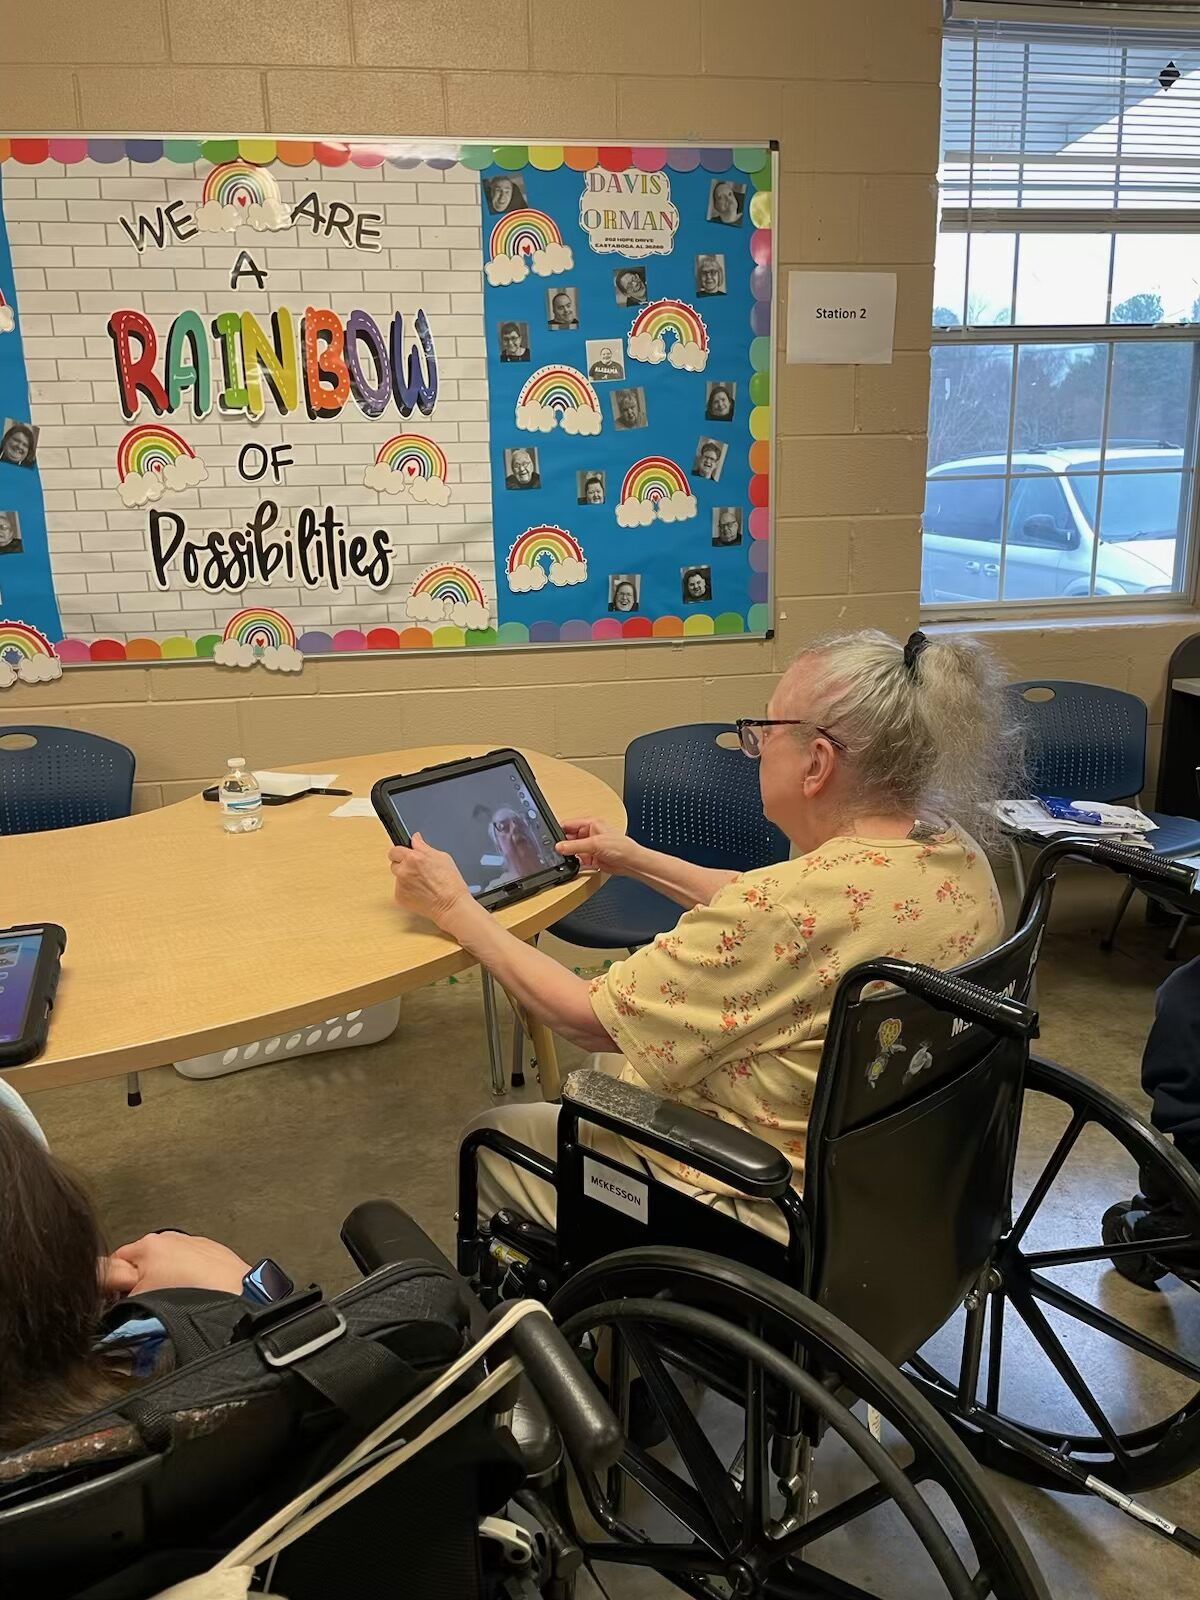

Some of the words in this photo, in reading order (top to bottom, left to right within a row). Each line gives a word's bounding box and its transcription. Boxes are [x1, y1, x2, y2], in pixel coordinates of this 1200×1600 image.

[588, 172, 662, 195] DAVIS
[119, 199, 199, 252] WE
[289, 192, 382, 251] ARE
[583, 208, 675, 231] ORMAN
[231, 250, 267, 289] A
[815, 307, 857, 319] Station
[860, 307, 867, 319] 2
[107, 305, 439, 420] RAINBOW
[237, 442, 294, 482] OF
[149, 499, 393, 591] Possibilities
